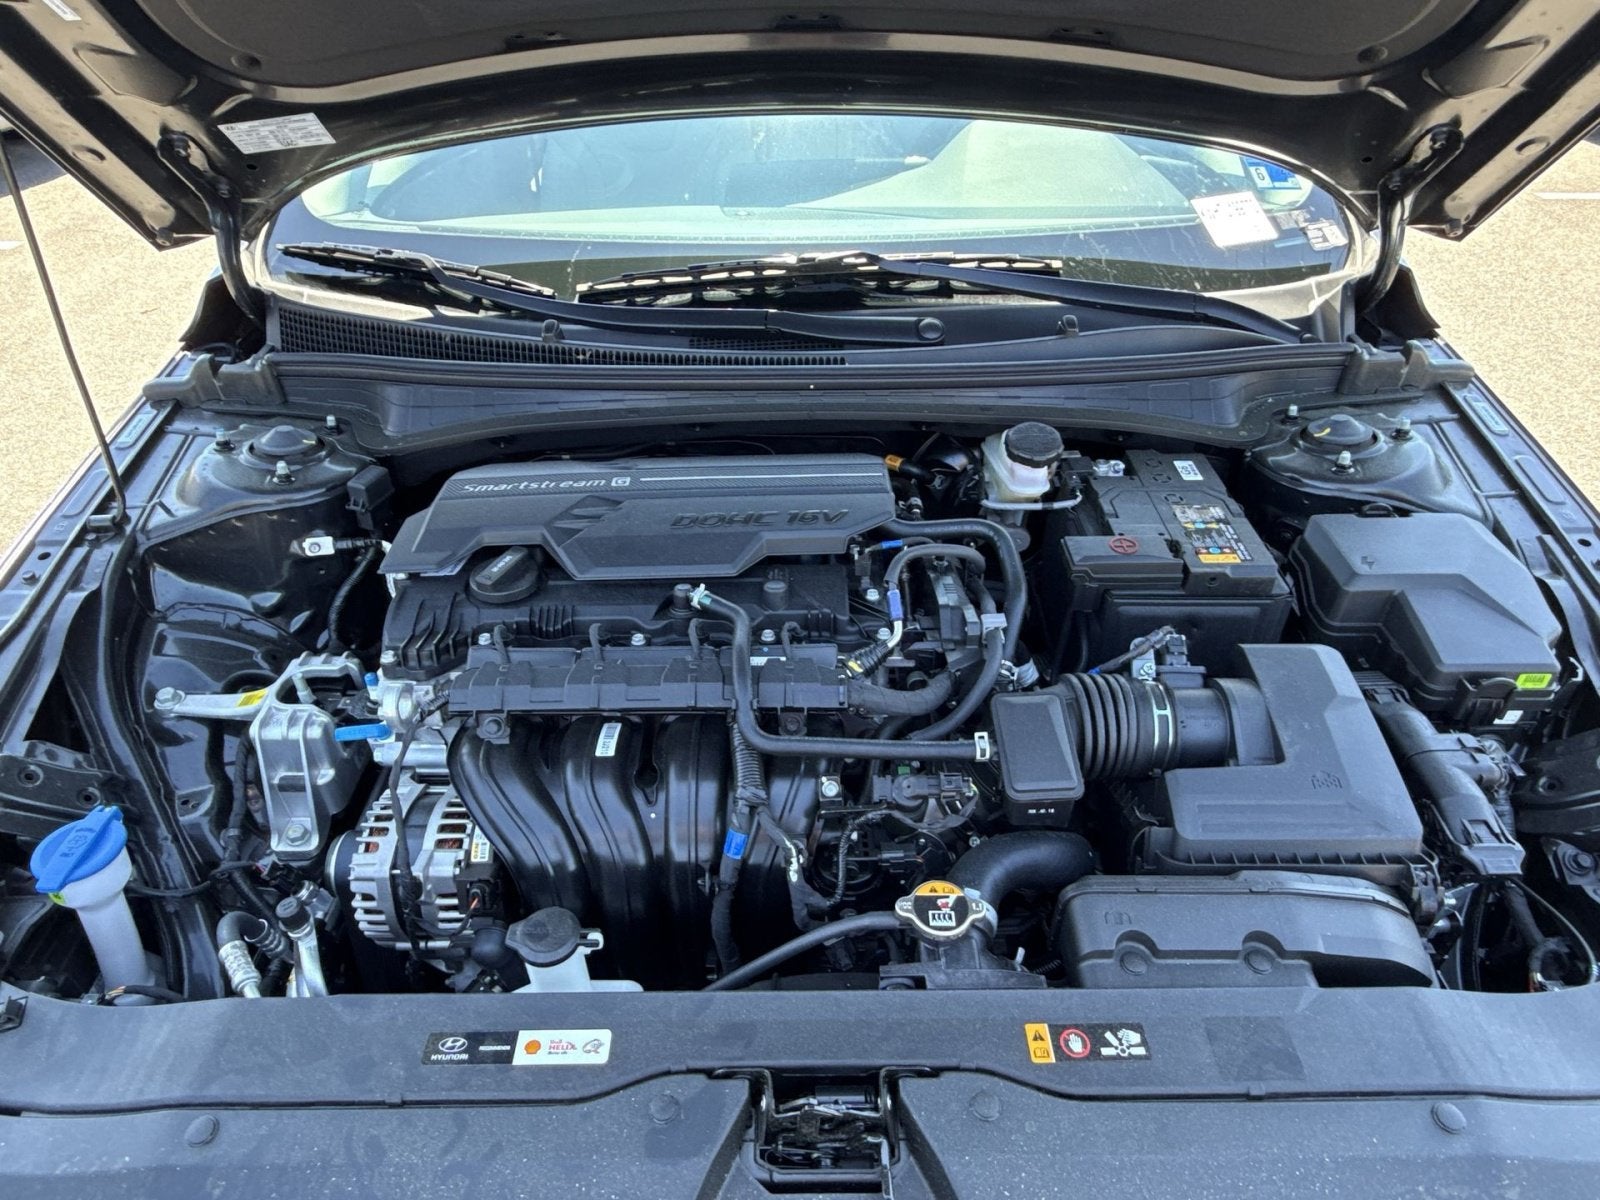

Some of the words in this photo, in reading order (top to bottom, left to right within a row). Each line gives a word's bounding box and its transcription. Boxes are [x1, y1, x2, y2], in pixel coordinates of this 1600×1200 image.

[1254, 167, 1266, 181] 6
[461, 478, 607, 493] Smartstream
[611, 476, 631, 487] G
[669, 510, 780, 529] DOHC
[786, 508, 850, 525] 16V
[549, 1043, 577, 1051] HELIX
[430, 1053, 469, 1061] HYUNDAI
